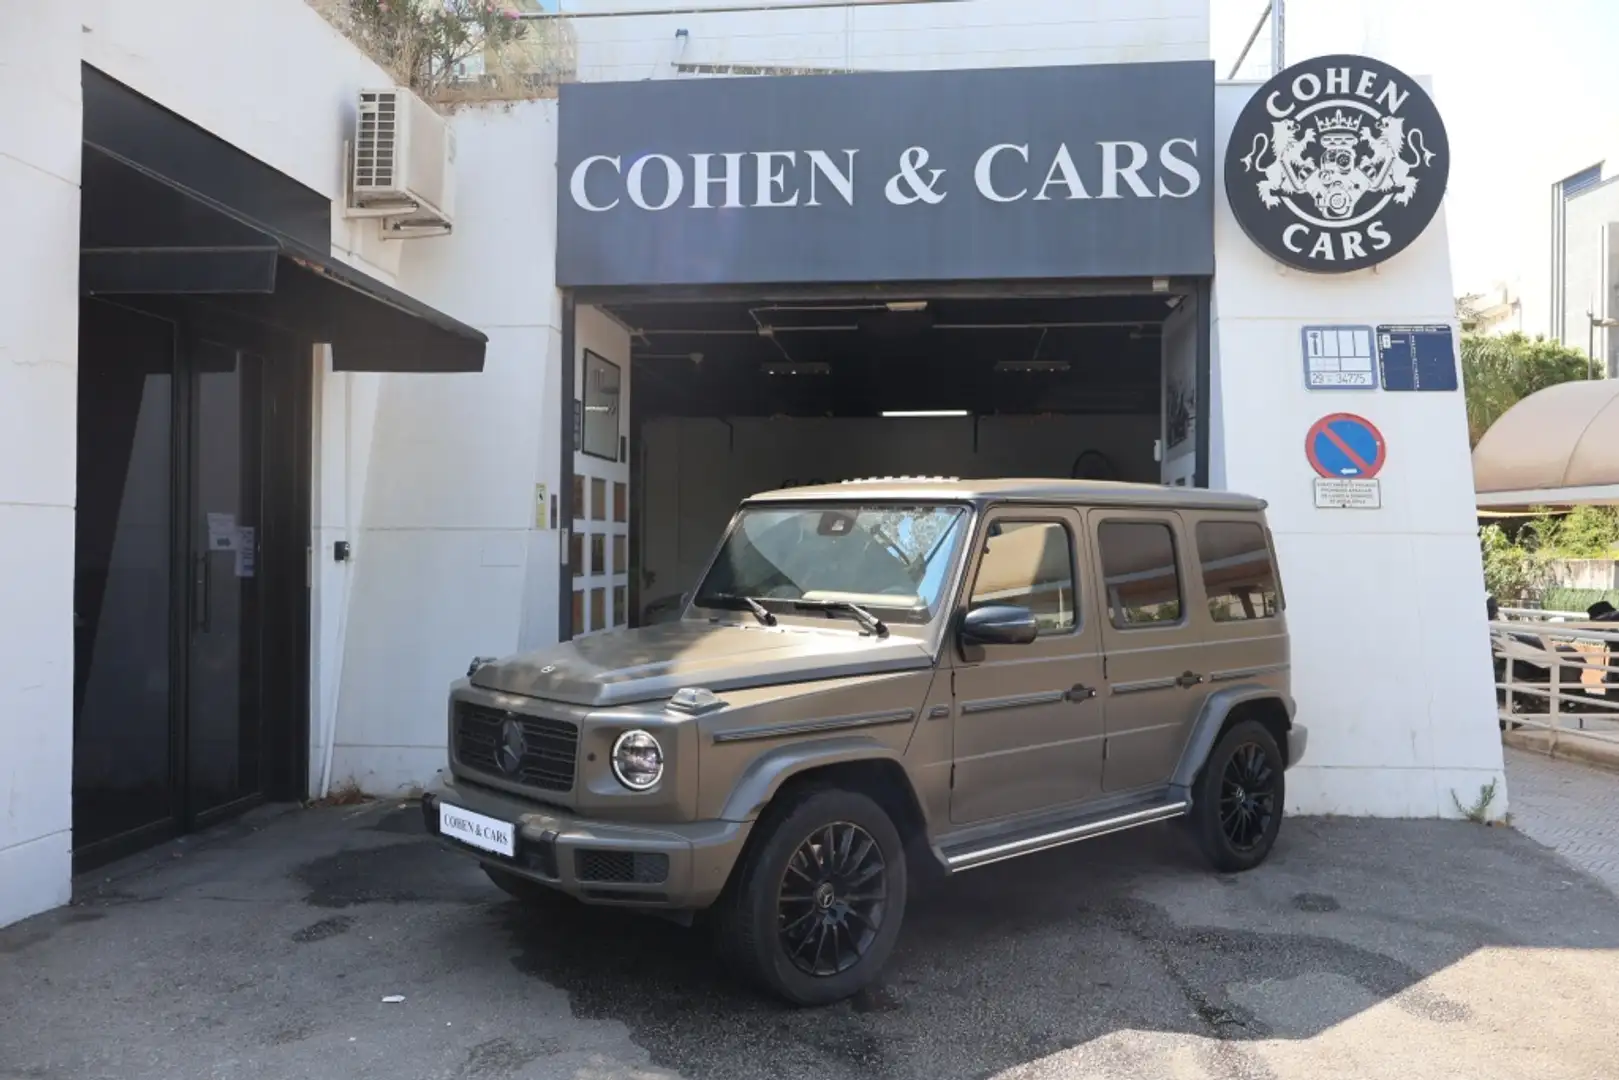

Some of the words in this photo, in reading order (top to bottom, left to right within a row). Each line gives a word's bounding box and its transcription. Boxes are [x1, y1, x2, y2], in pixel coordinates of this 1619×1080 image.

[1266, 67, 1410, 118] COHEN
[570, 148, 860, 212] COHEN
[884, 145, 948, 205] &
[974, 137, 1201, 202] CARS
[1282, 220, 1391, 261] CARS
[1312, 373, 1324, 384] 29
[1336, 373, 1366, 384] 34775
[444, 813, 474, 833] COHEN
[474, 823, 482, 836] &
[483, 826, 509, 846] CARS
